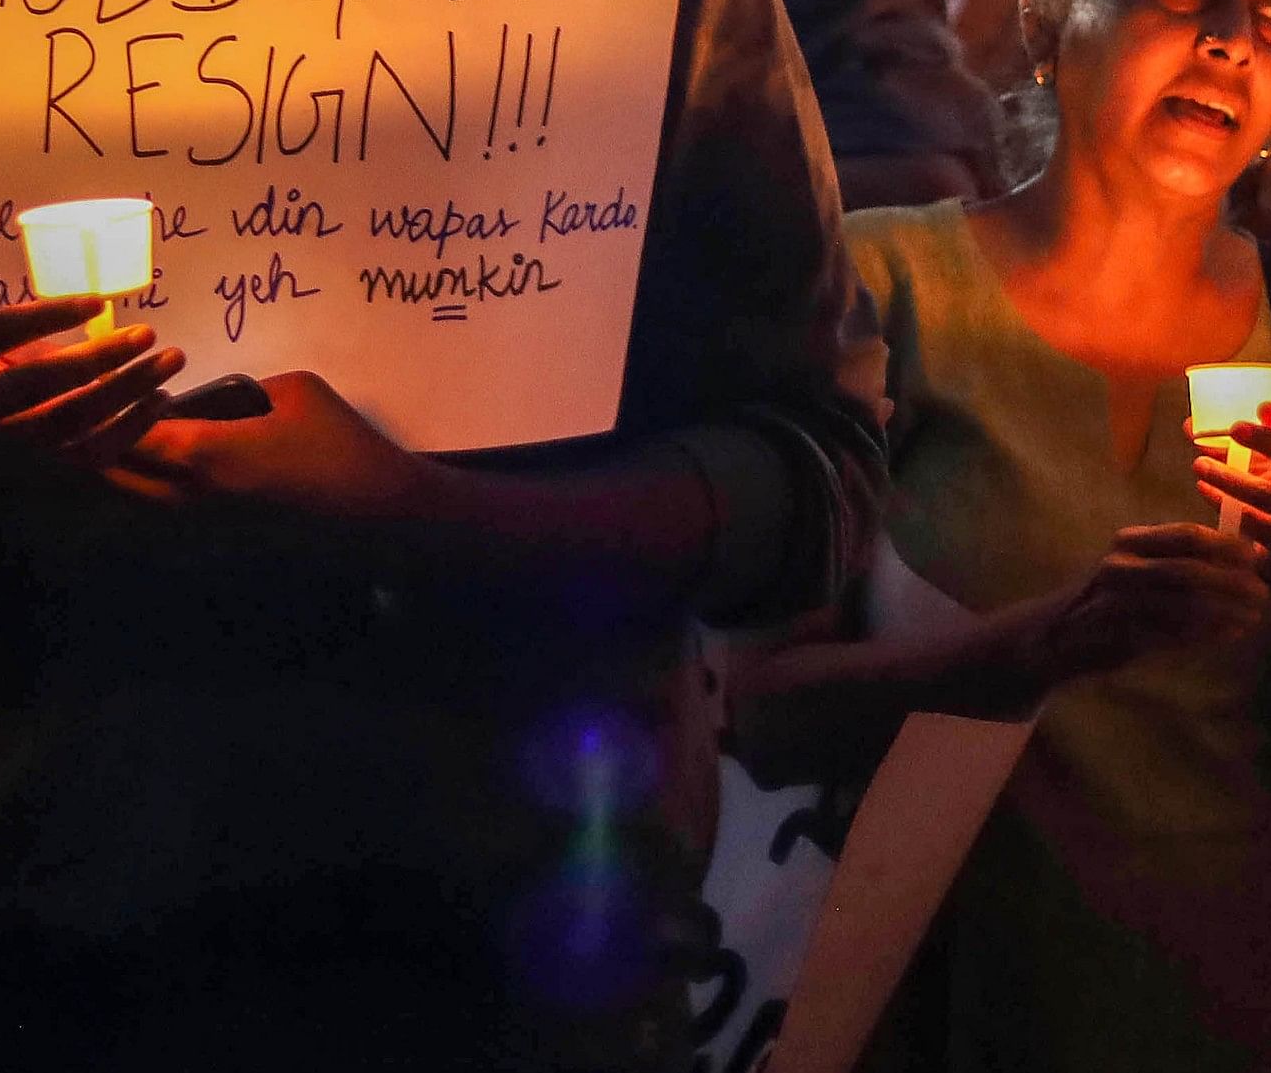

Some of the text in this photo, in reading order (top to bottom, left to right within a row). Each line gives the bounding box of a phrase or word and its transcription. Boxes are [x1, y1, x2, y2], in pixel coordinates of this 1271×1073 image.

[232, 185, 344, 238] din
[370, 200, 519, 259] wapas
[215, 253, 321, 343] yeh
